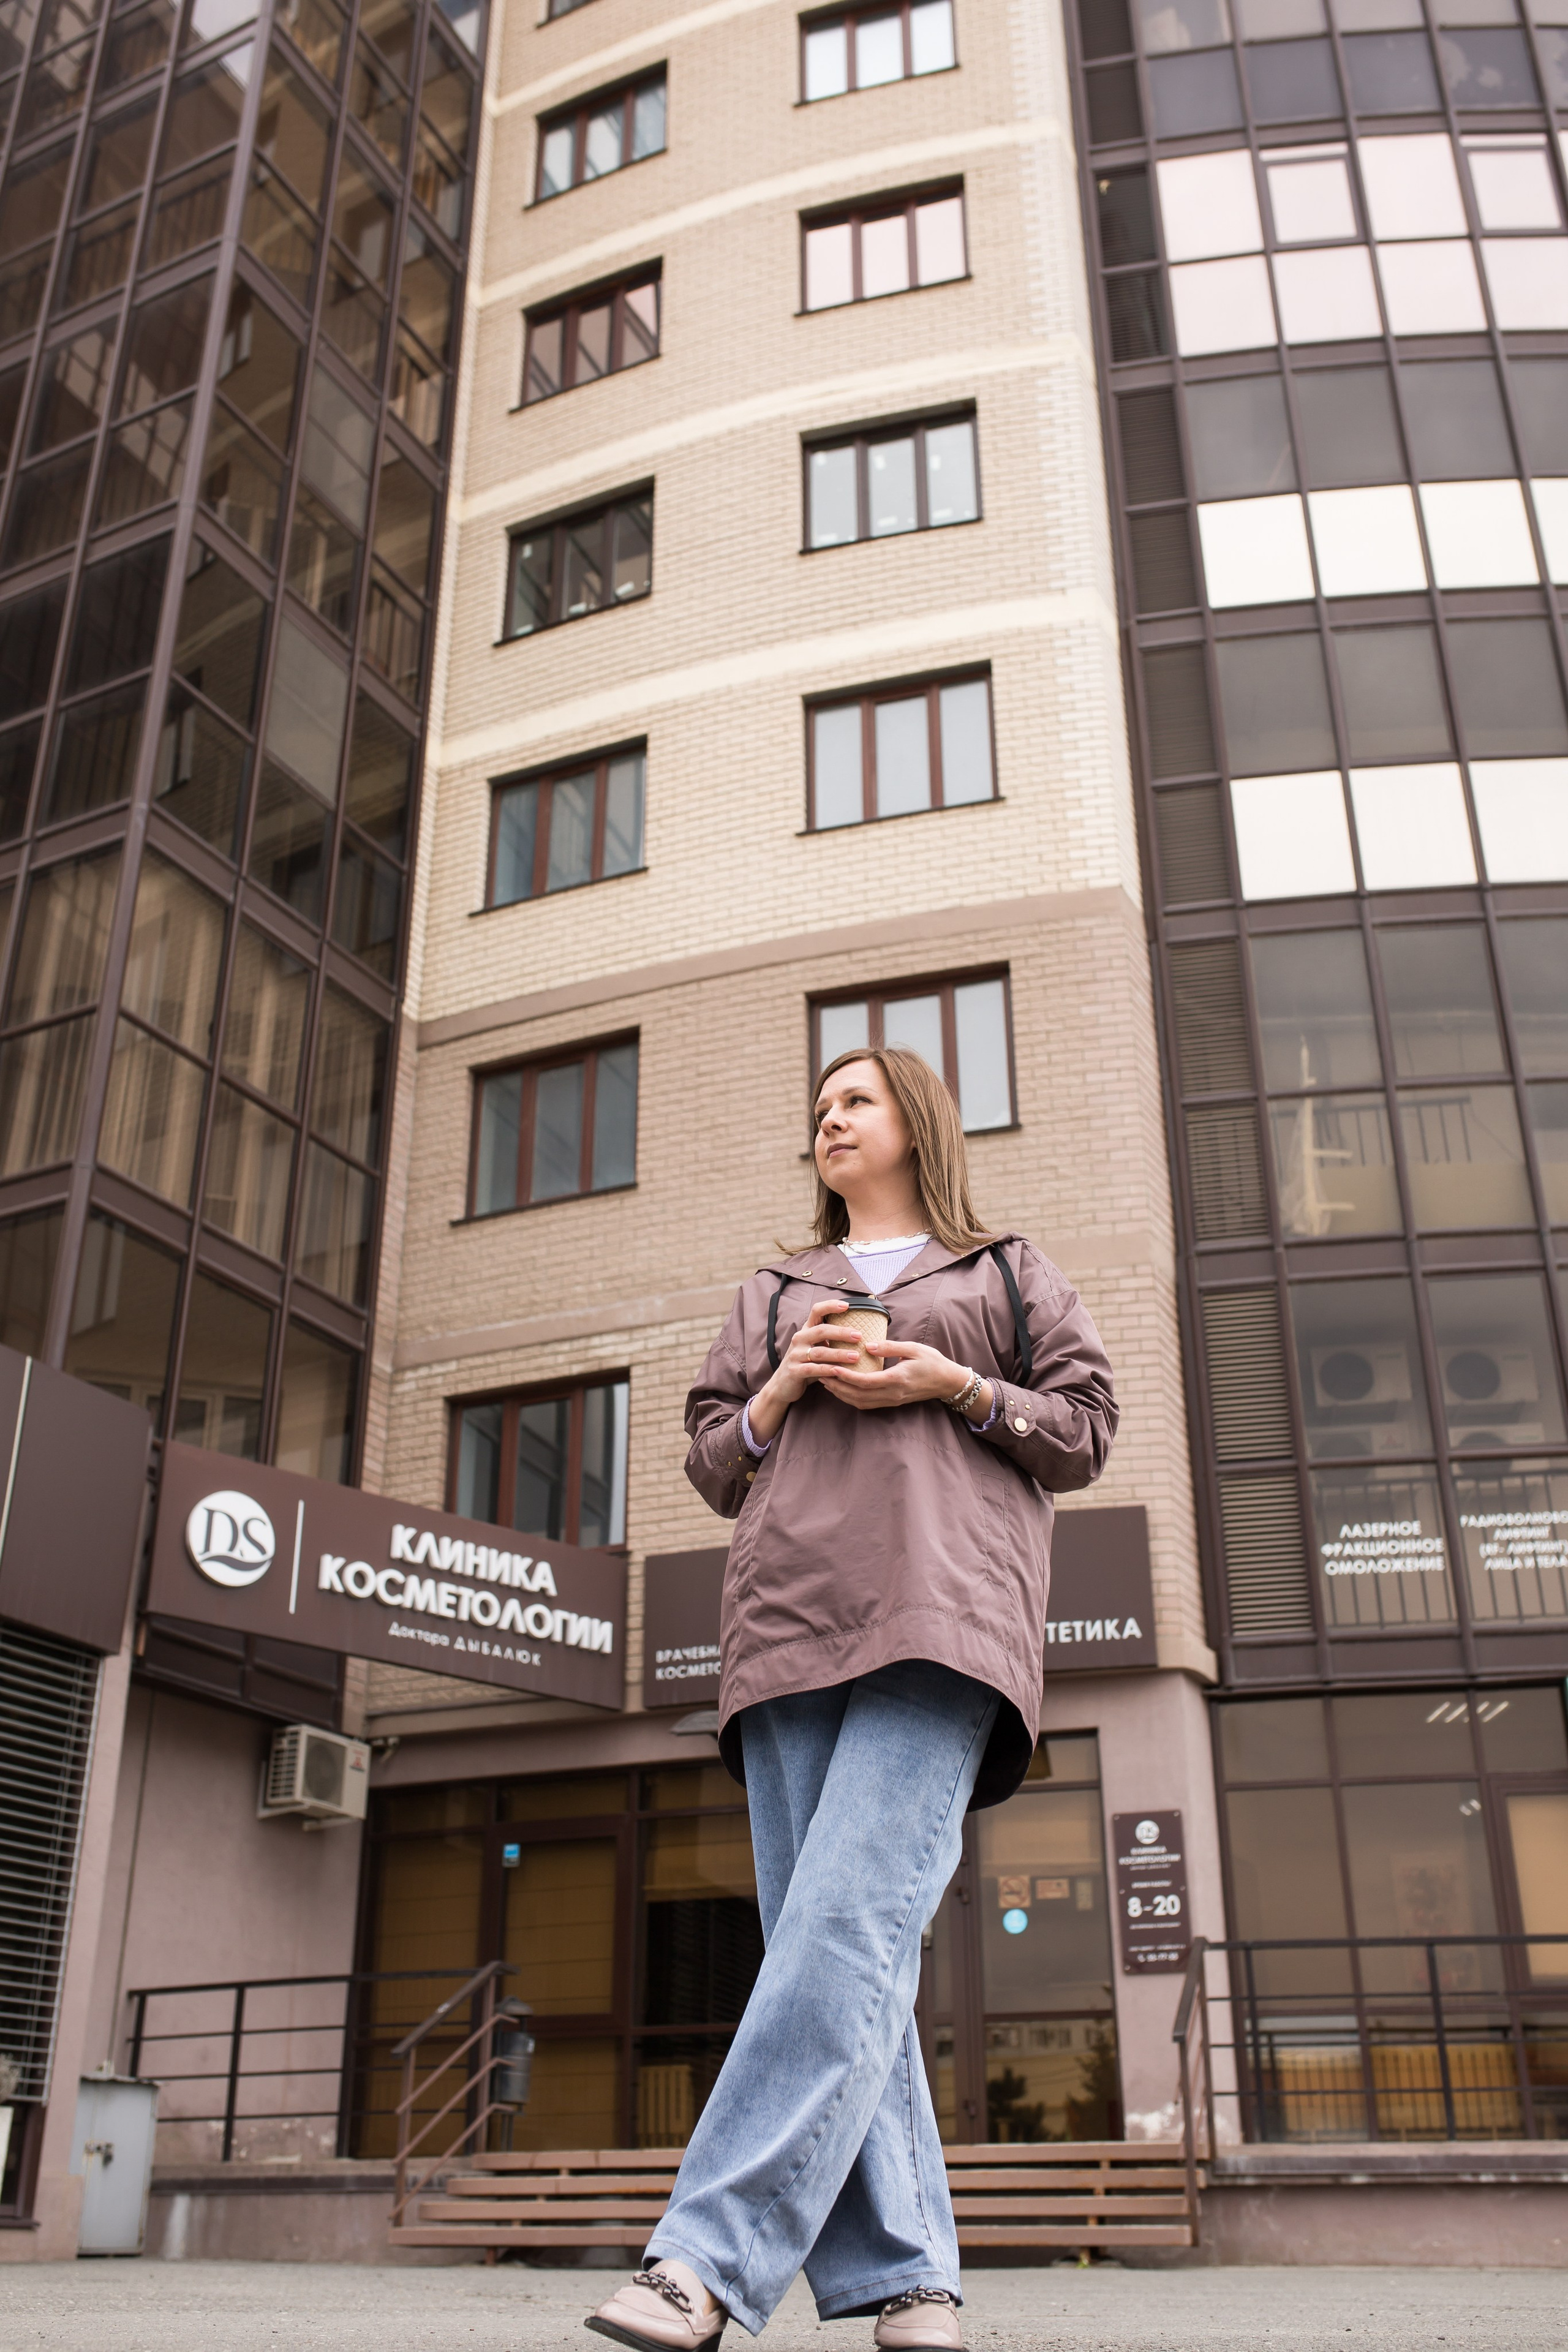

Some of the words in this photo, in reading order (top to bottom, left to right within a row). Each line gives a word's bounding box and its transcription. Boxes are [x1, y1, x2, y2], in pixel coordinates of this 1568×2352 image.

[198, 1506, 266, 1557] DS
[1321, 1537, 1445, 1557] ФРАКЦИОННОЕ
[1340, 1520, 1422, 1539] ЛАЗЕРНОЕ
[390, 1523, 558, 1596] КЛИНИКА
[1325, 1556, 1445, 1576] ОМОЛОЖЕНИЕ
[318, 1553, 612, 1654] КОСМЕТОЛОГИИ
[388, 1621, 450, 1646] Доктора
[453, 1635, 541, 1667] ДЫБАЛЮК
[1128, 1894, 1181, 1918] 8-20
